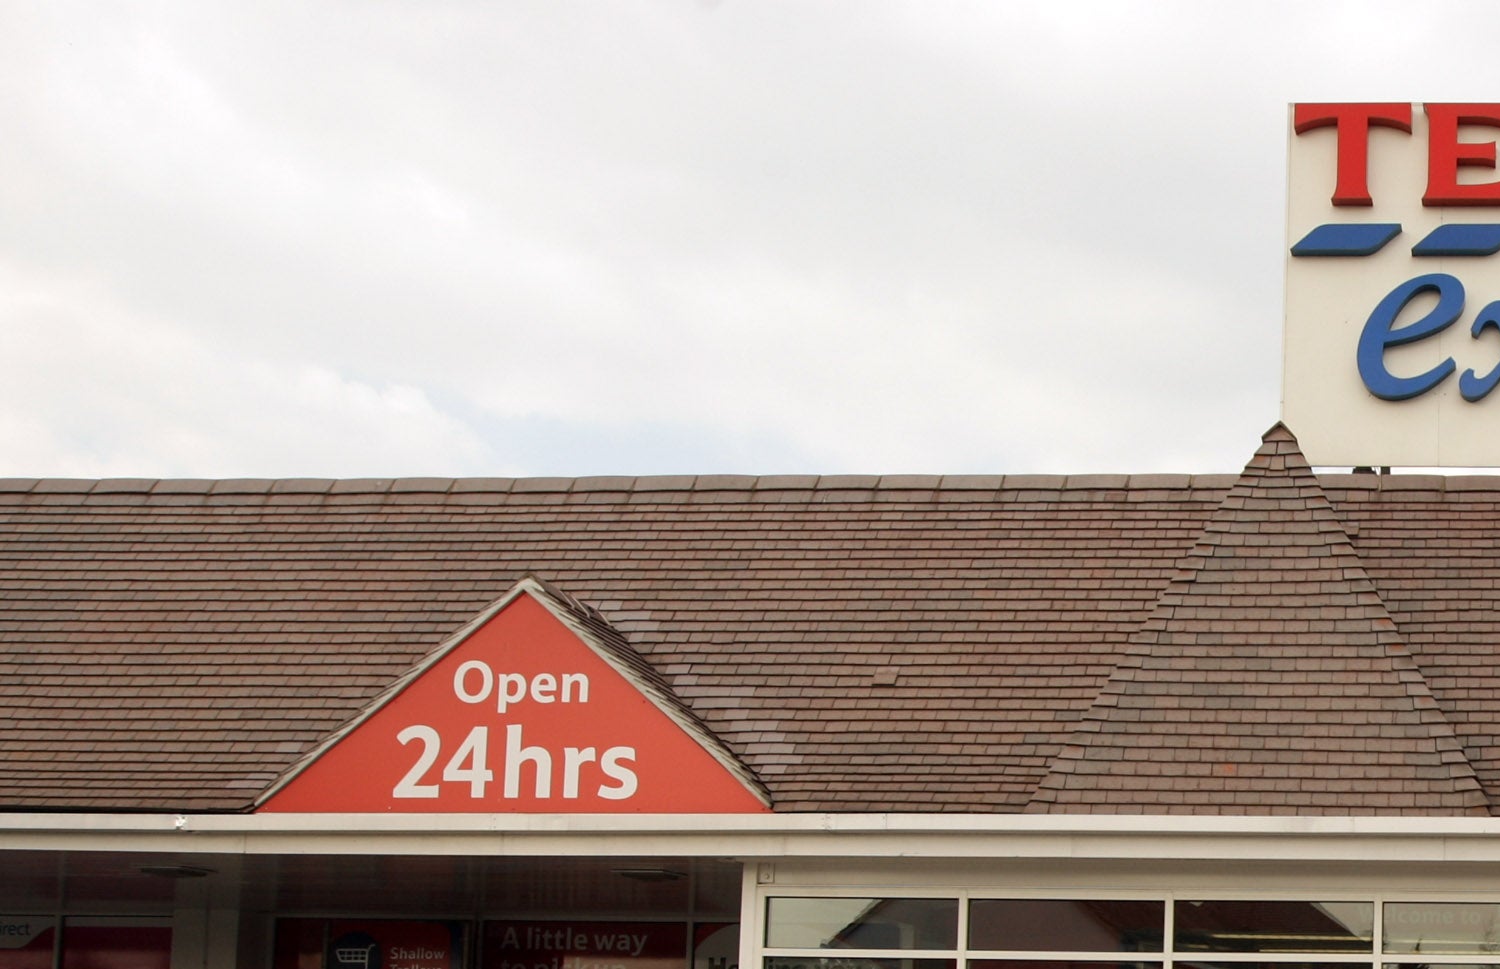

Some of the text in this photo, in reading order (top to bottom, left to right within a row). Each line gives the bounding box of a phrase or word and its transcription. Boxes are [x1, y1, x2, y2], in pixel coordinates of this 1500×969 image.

[453, 660, 589, 713] Open
[393, 724, 638, 800] 24hrs
[389, 947, 445, 960] Shallow
[501, 926, 648, 956] A little way
